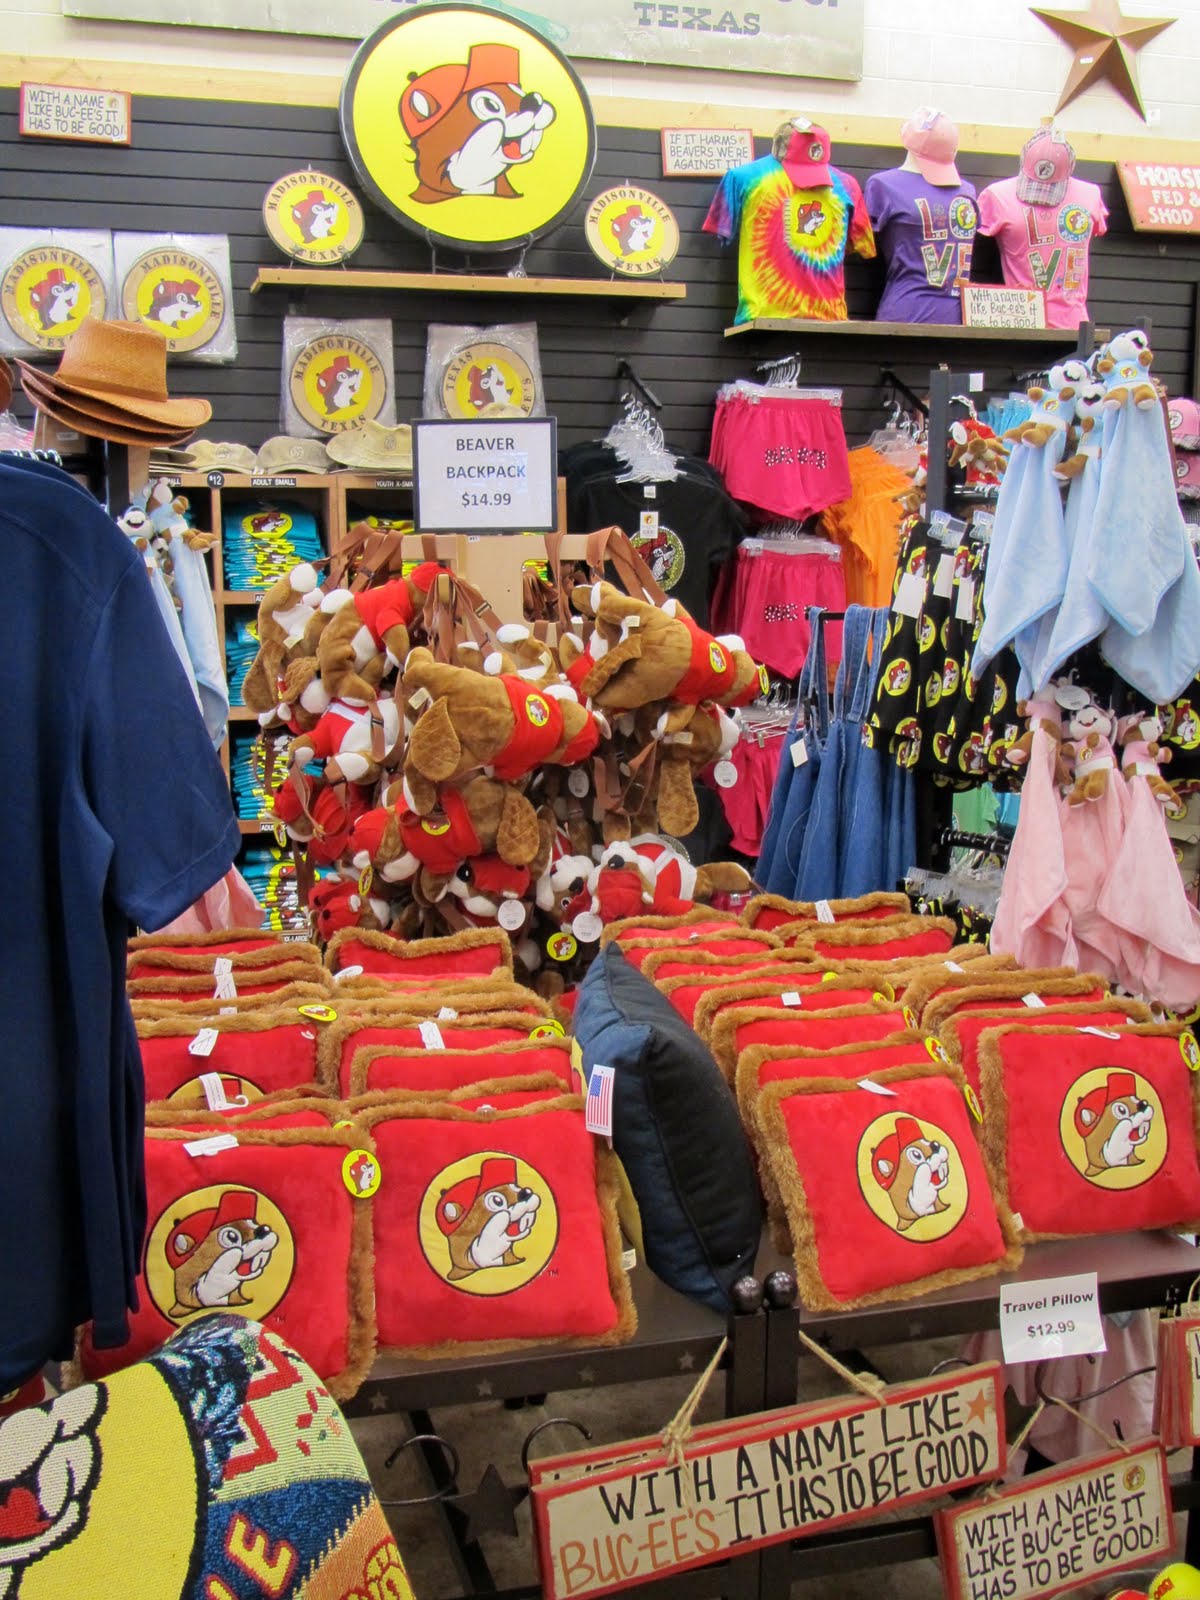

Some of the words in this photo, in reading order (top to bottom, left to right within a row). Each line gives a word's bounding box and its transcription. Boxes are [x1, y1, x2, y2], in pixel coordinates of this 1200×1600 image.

[633, 2, 761, 36] TEXAS
[29, 90, 61, 104] WITH
[63, 93, 71, 105] A
[73, 94, 105, 109] NAME
[28, 103, 53, 117] LIKE
[55, 105, 103, 122] BUC-EE'S
[105, 110, 118, 122] IT
[29, 117, 51, 130] HAS
[55, 119, 68, 133] TO
[71, 121, 84, 134] BE
[88, 122, 124, 137] GOOD!
[669, 134, 681, 145] IF
[684, 134, 696, 145] IT
[699, 134, 738, 146] HARMS
[669, 145, 714, 158] BEAVERS
[673, 158, 721, 170] AGAINST
[267, 174, 356, 211] MADISONVILLE
[1151, 189, 1185, 207] FED
[589, 189, 671, 225] MADISONVILLE
[1148, 206, 1194, 226] SHOD
[5, 251, 98, 295] MADISONVILLE
[140, 254, 220, 320] MADISONVILLE
[970, 288, 992, 302] With
[1000, 291, 1026, 305] name
[970, 302, 988, 316] like
[1029, 303, 1038, 316] it
[989, 316, 999, 328] to
[294, 338, 380, 381] MADISONVILLE
[446, 351, 474, 391] TEXAS
[320, 414, 366, 432] TEXAS
[456, 437, 515, 451] BEAVER
[209, 475, 222, 486] $12
[446, 465, 527, 479] BACKPACK
[252, 478, 273, 486] ADULT
[274, 478, 296, 486] SMALL
[461, 491, 512, 508] $14.99
[1003, 1298, 1047, 1314] Travel
[1051, 1292, 1095, 1307] Pillow
[1027, 1320, 1076, 1338] $12.99
[599, 1455, 716, 1525] WITH
[736, 1445, 759, 1491] A
[768, 1413, 867, 1481] NAME
[880, 1391, 964, 1446] LIKE
[559, 1508, 721, 1596] BUC-EE'S
[726, 1488, 768, 1546] IT
[775, 1475, 836, 1530] HAS
[828, 1461, 864, 1513] TO
[867, 1446, 910, 1508] BE
[914, 1430, 989, 1490] GOOD
[964, 1501, 1029, 1550] WITH
[1036, 1499, 1050, 1525] A
[1055, 1473, 1116, 1521] NAME
[965, 1538, 1017, 1579] LIKE
[1021, 1504, 1118, 1559] BUC-EE'S
[1120, 1491, 1146, 1525] IT
[971, 1569, 1018, 1600] HAS
[1022, 1558, 1052, 1588] TO
[1057, 1544, 1084, 1580] BE
[1093, 1516, 1161, 1564] GOOD!
